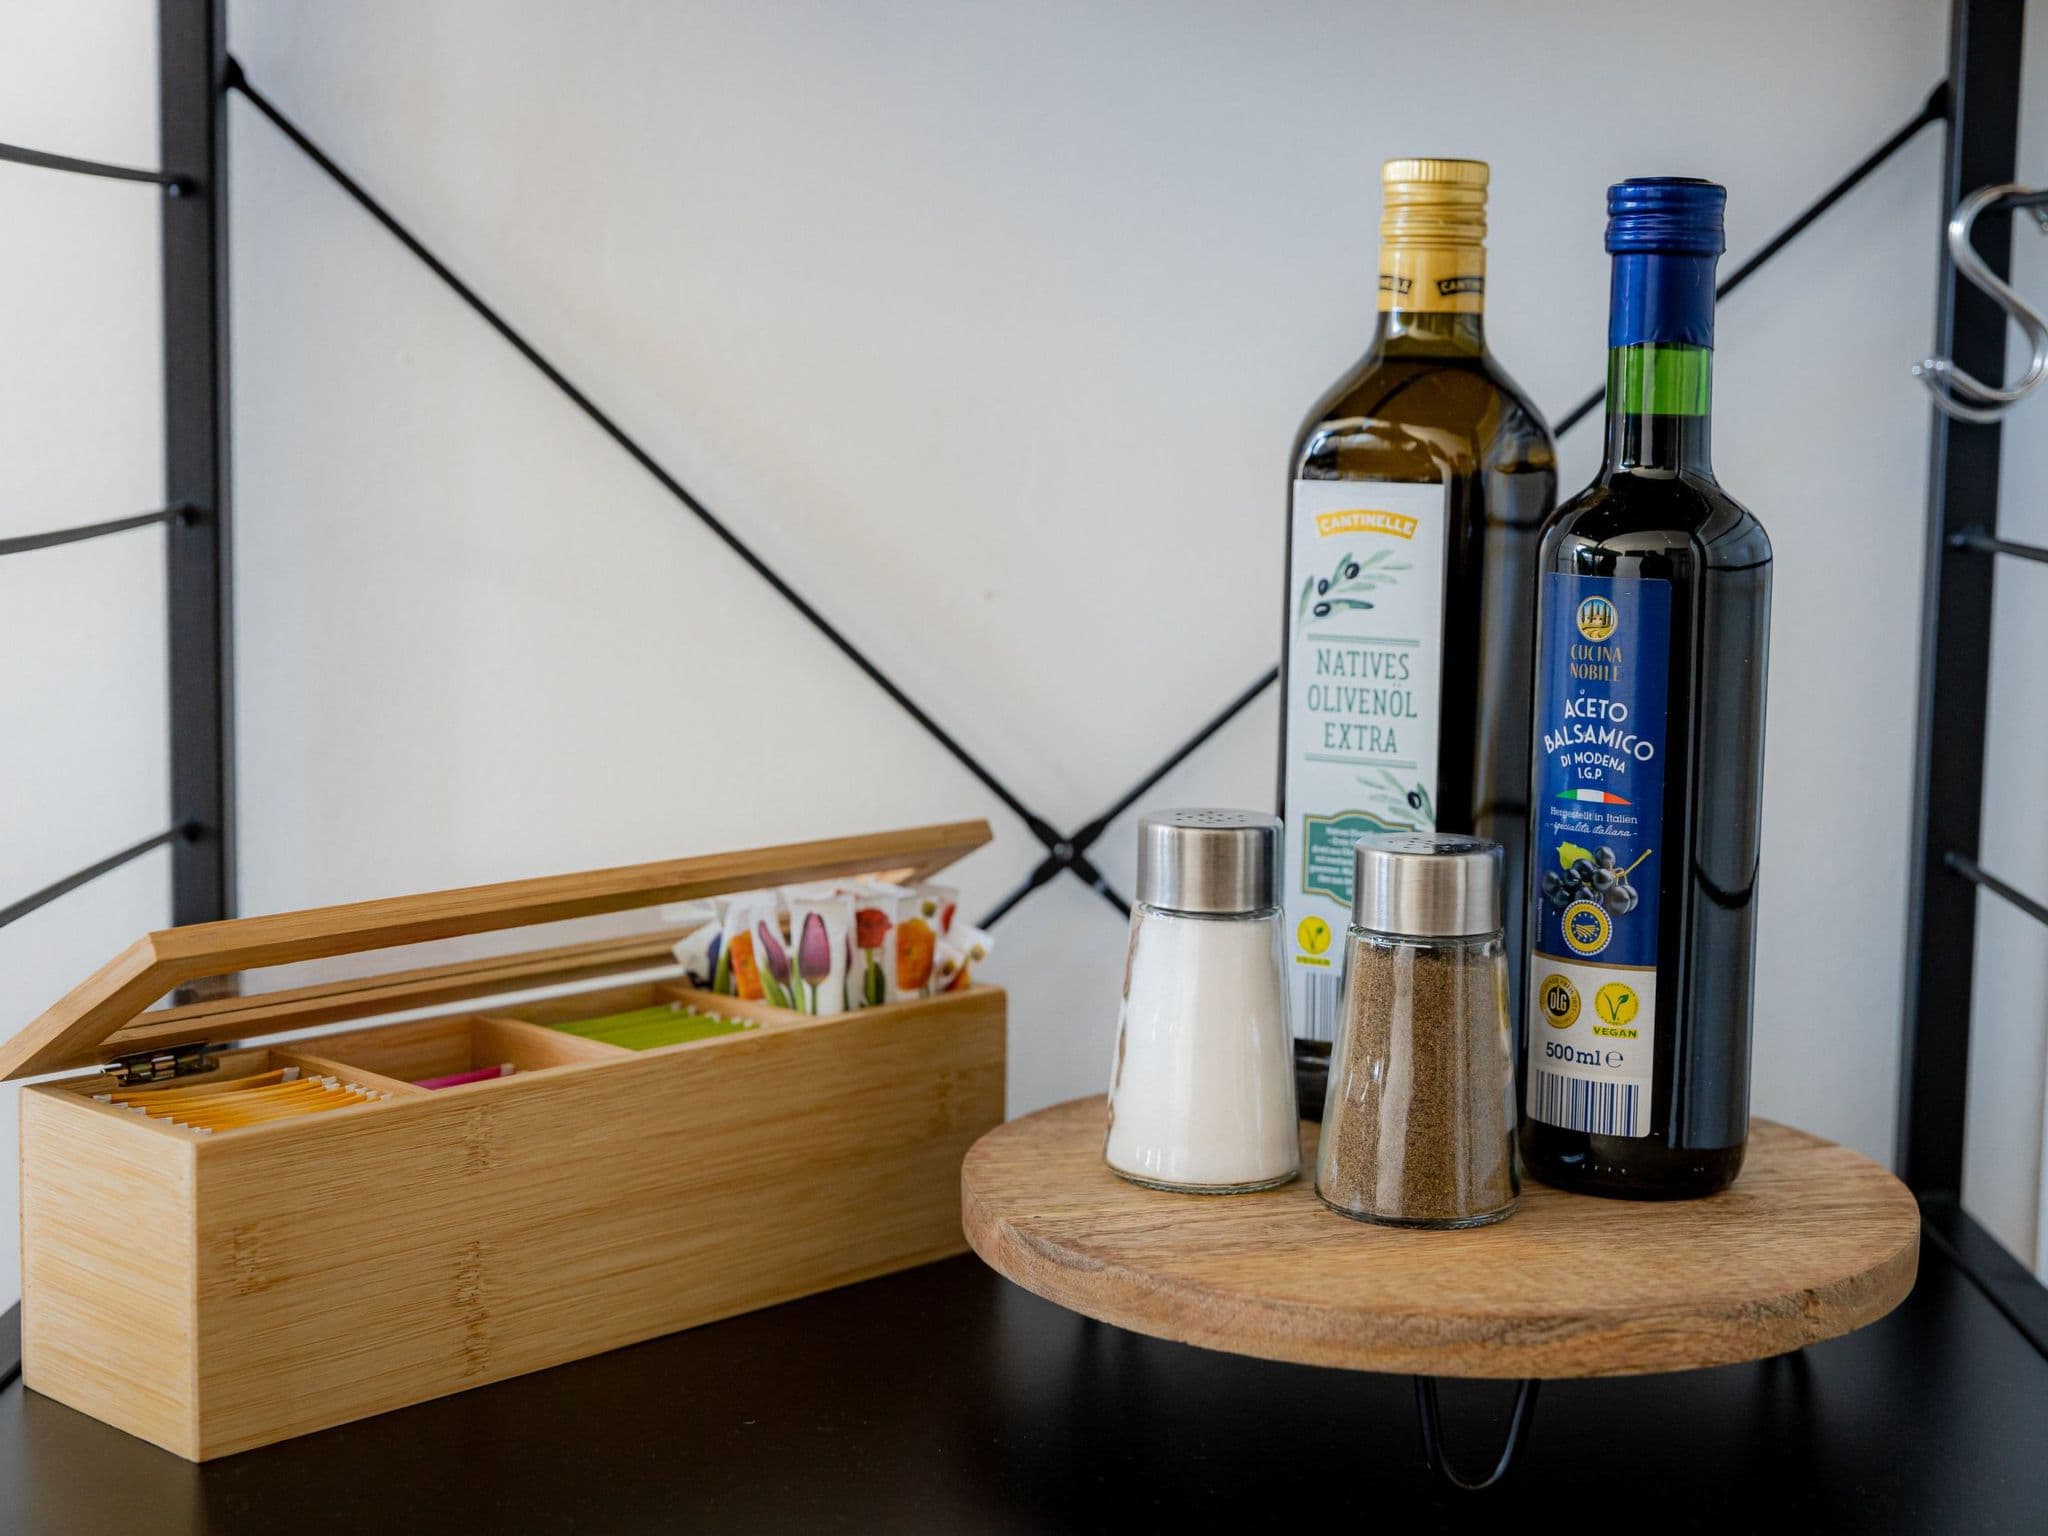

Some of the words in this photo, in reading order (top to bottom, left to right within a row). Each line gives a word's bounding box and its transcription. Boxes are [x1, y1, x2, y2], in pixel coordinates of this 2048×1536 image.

[1320, 514, 1413, 536] CANTINELLE
[1316, 648, 1410, 681] NATIVES
[1570, 643, 1622, 663] CUCINA
[1570, 662, 1621, 682] NOBILE
[1307, 682, 1418, 718] OLIVENÖL
[1564, 697, 1628, 722] ACETO
[1324, 721, 1398, 753] EXTRA
[1543, 723, 1655, 761] BALSAMICO
[1560, 753, 1572, 768] DI
[1574, 751, 1625, 774] MODENA
[1577, 767, 1604, 781] I.G.P.
[1594, 810, 1604, 822] in
[1606, 813, 1638, 824] Italien
[1550, 987, 1567, 1012] DLG
[1592, 1025, 1637, 1038] VEGAN
